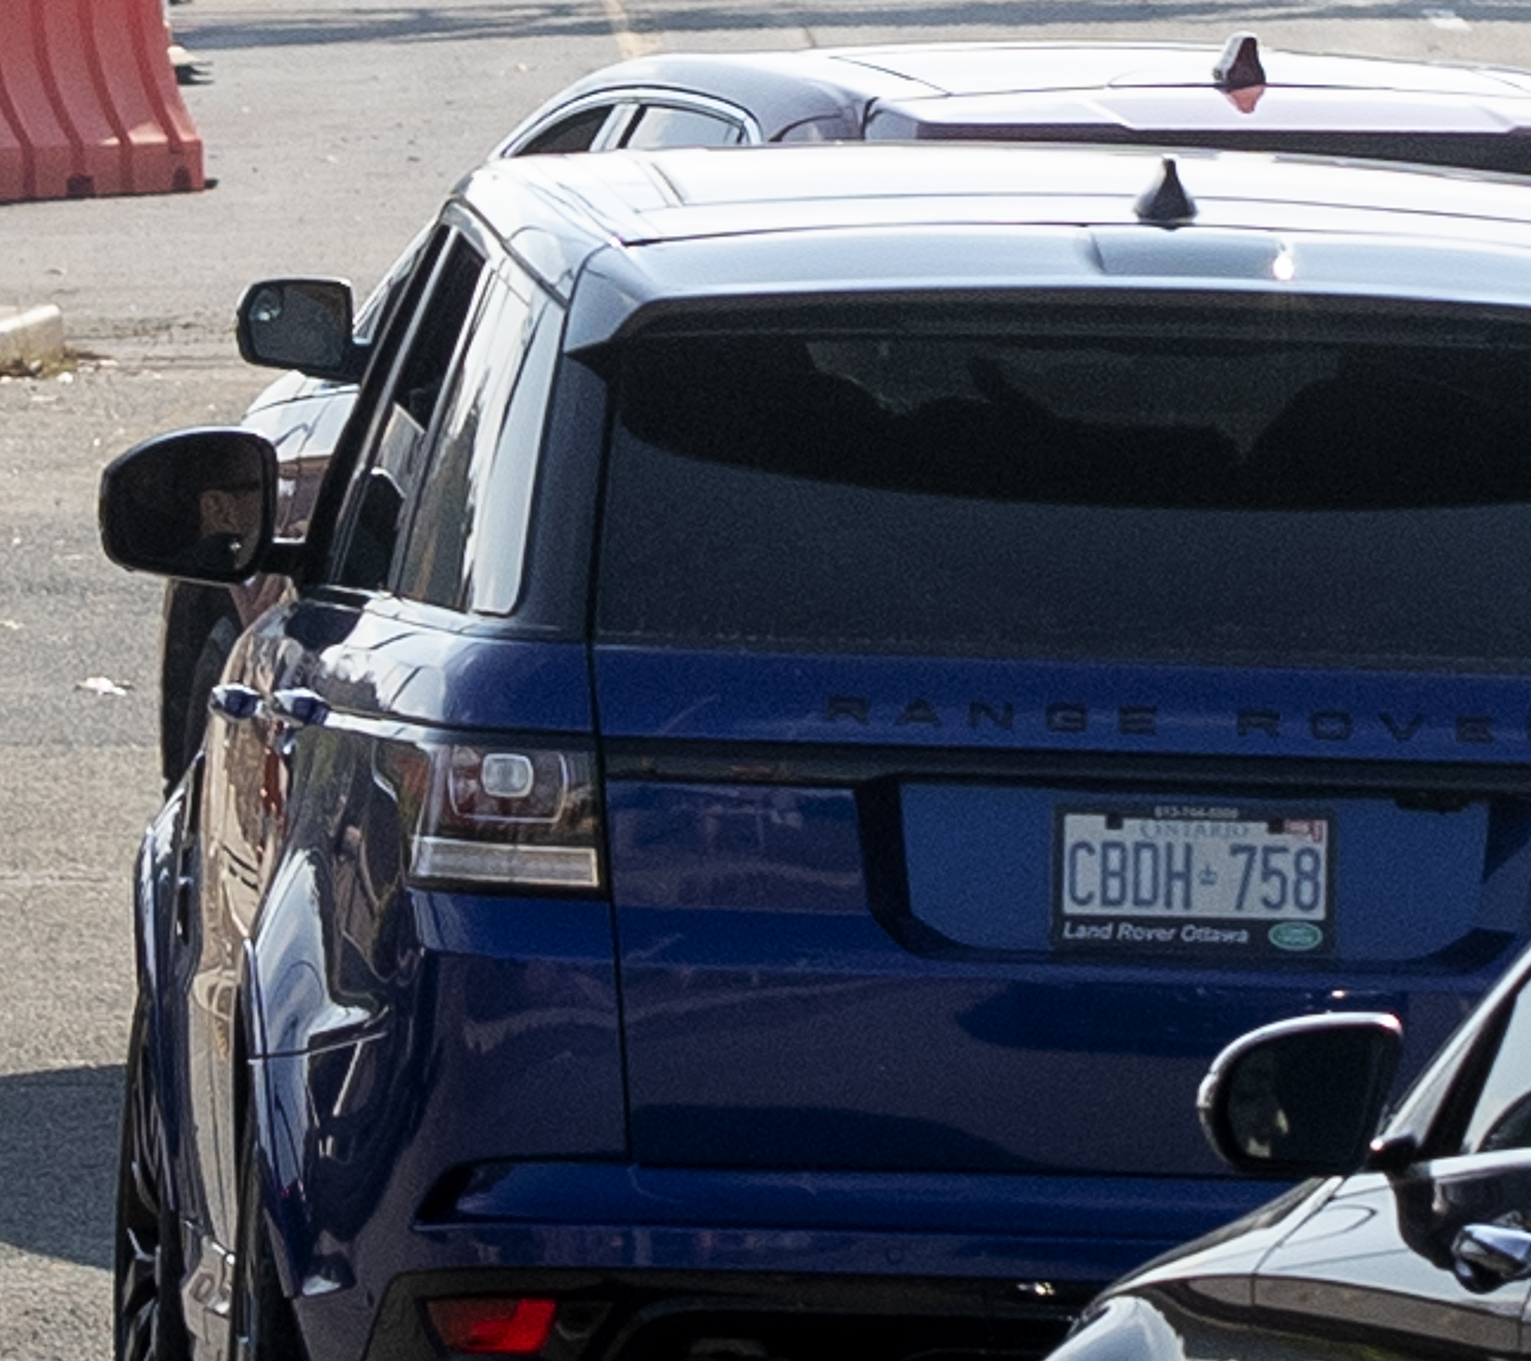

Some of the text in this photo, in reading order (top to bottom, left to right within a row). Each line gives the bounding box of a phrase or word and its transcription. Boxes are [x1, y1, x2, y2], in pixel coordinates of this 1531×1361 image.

[826, 694, 1158, 736] RANGE
[1069, 840, 1322, 912] CBDH 758
[1062, 921, 1249, 944] Land Rover Ottawa
